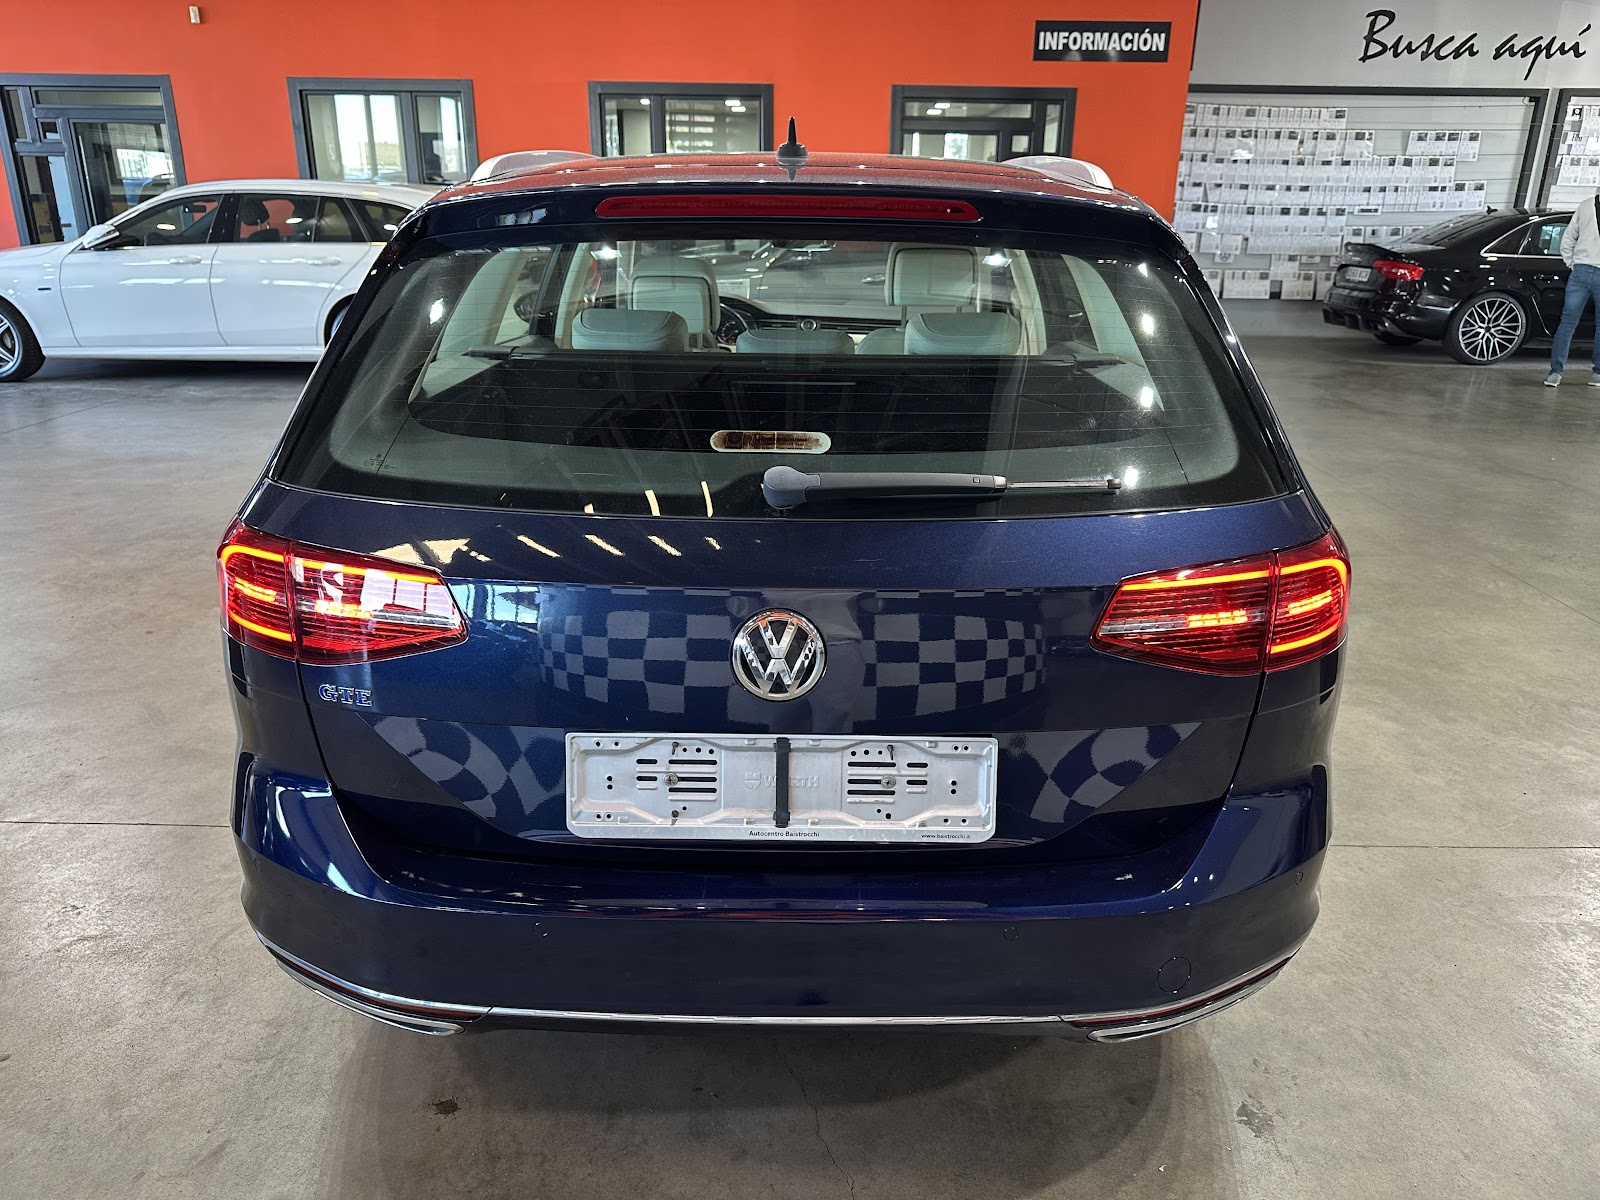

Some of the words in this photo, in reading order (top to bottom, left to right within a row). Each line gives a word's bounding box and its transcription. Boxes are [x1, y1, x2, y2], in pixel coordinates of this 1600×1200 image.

[1038, 28, 1166, 52] INFORMACIÓN
[1358, 9, 1479, 63] Busca
[1492, 23, 1592, 81] aquí
[318, 684, 373, 707] GTE
[763, 775, 819, 789] WRTH
[785, 830, 820, 838] Baistrocchi
